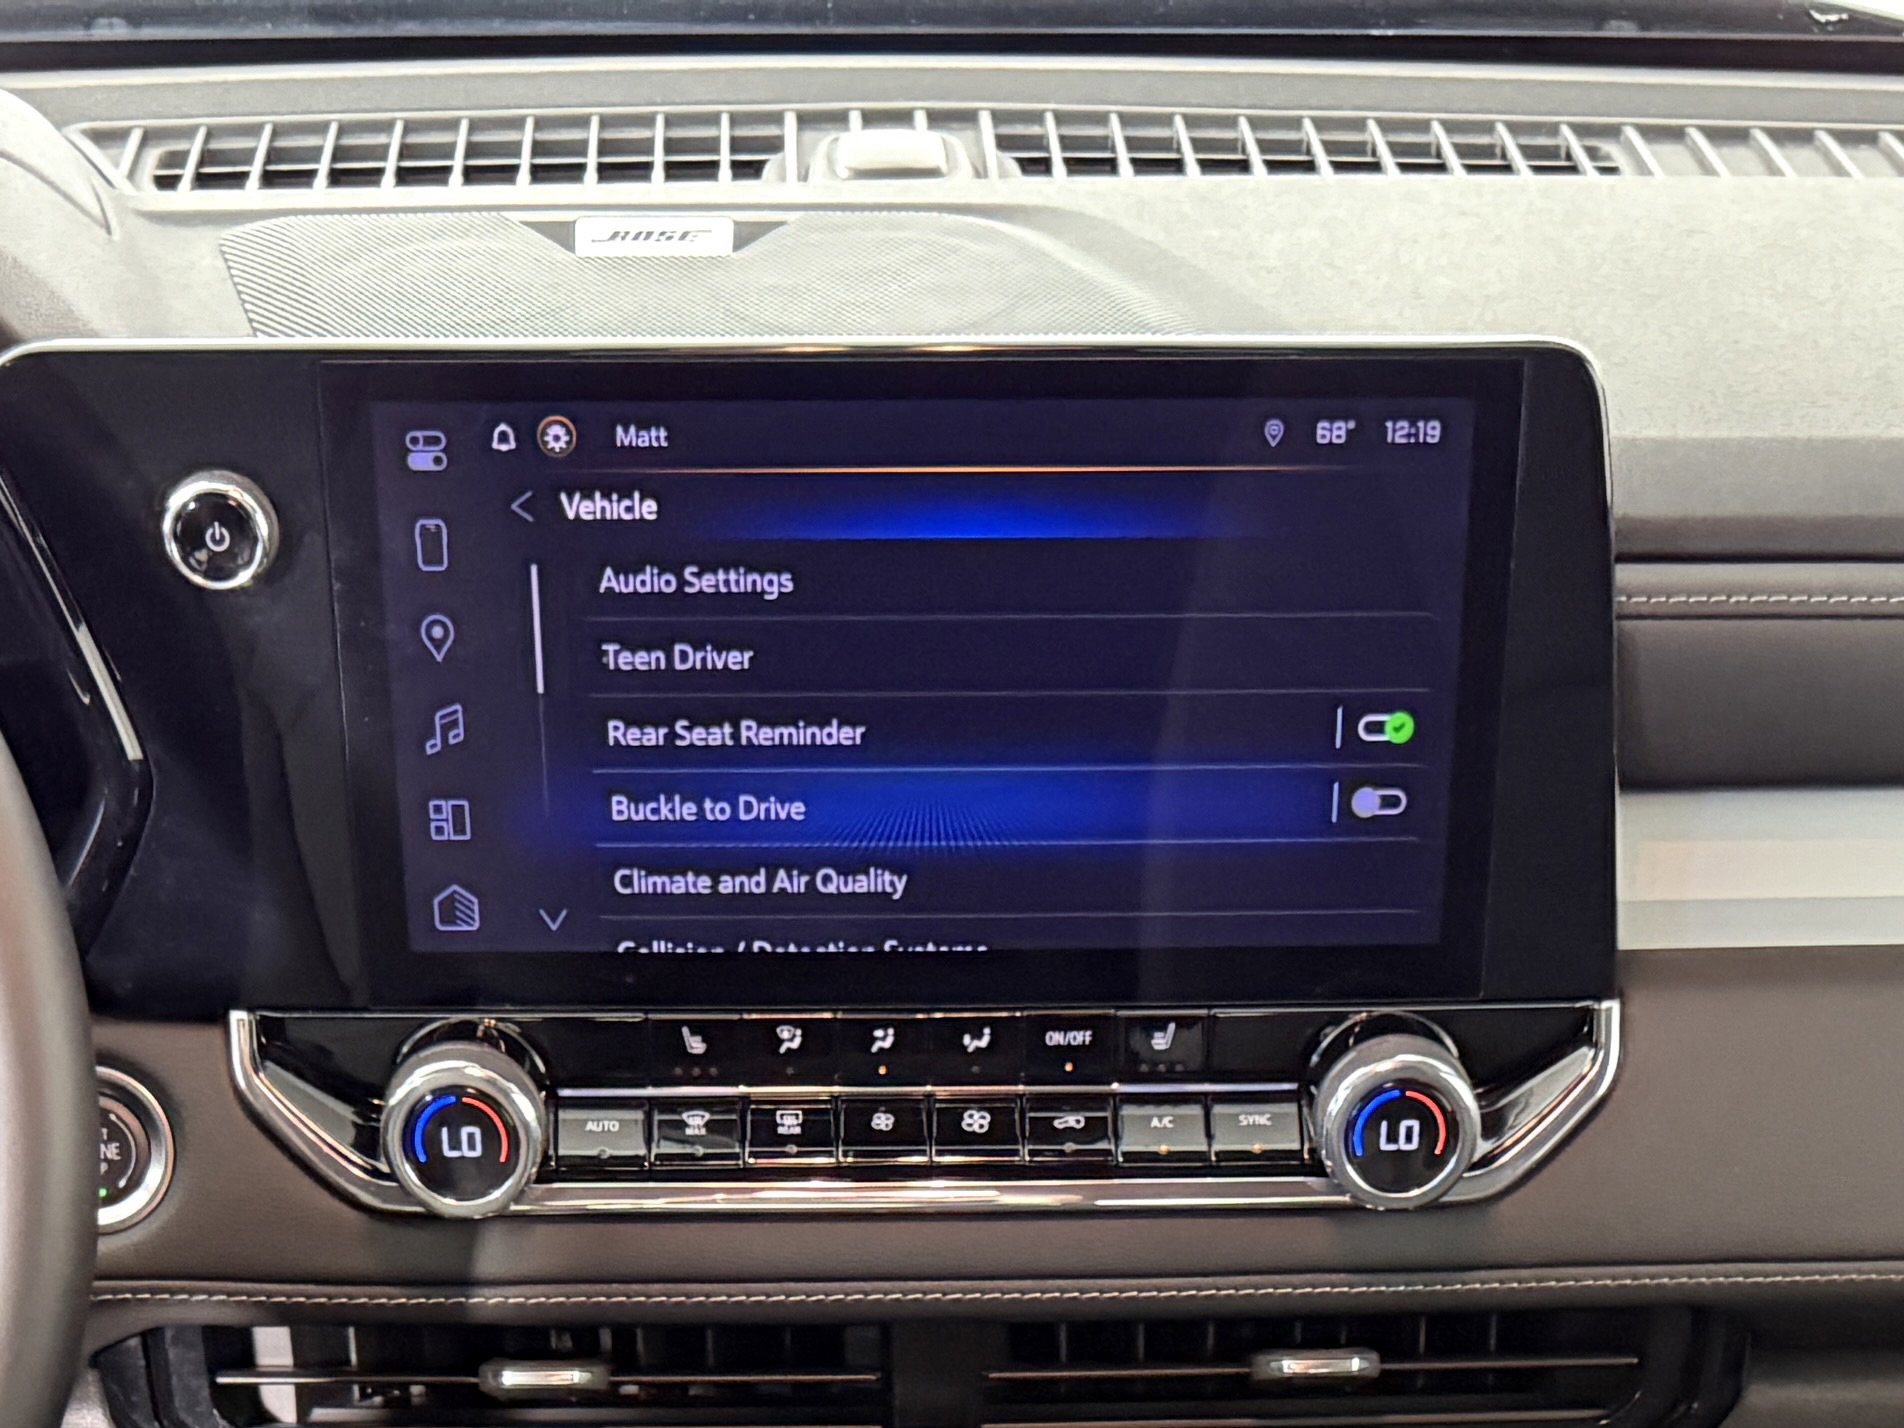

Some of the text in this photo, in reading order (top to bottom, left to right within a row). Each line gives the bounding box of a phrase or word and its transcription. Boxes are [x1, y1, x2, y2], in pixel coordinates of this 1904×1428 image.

[591, 229, 712, 243] BOSE
[615, 424, 669, 448] Matt
[1384, 419, 1441, 444] 12:19
[559, 490, 658, 521] Vehicle
[599, 564, 795, 601] Audio Settings
[600, 642, 754, 671] Teen Driver
[607, 718, 866, 747] Rear Seat Reminder
[611, 794, 806, 821] Buckle to Drive
[613, 867, 908, 901] Climate and Air Quality
[1045, 1030, 1093, 1048] ON/OFF
[585, 1120, 620, 1133] AUTO
[1150, 1115, 1174, 1129] A/C
[1239, 1113, 1272, 1127] SYNC
[441, 1125, 483, 1159] LO
[1379, 1119, 1421, 1152] LO
